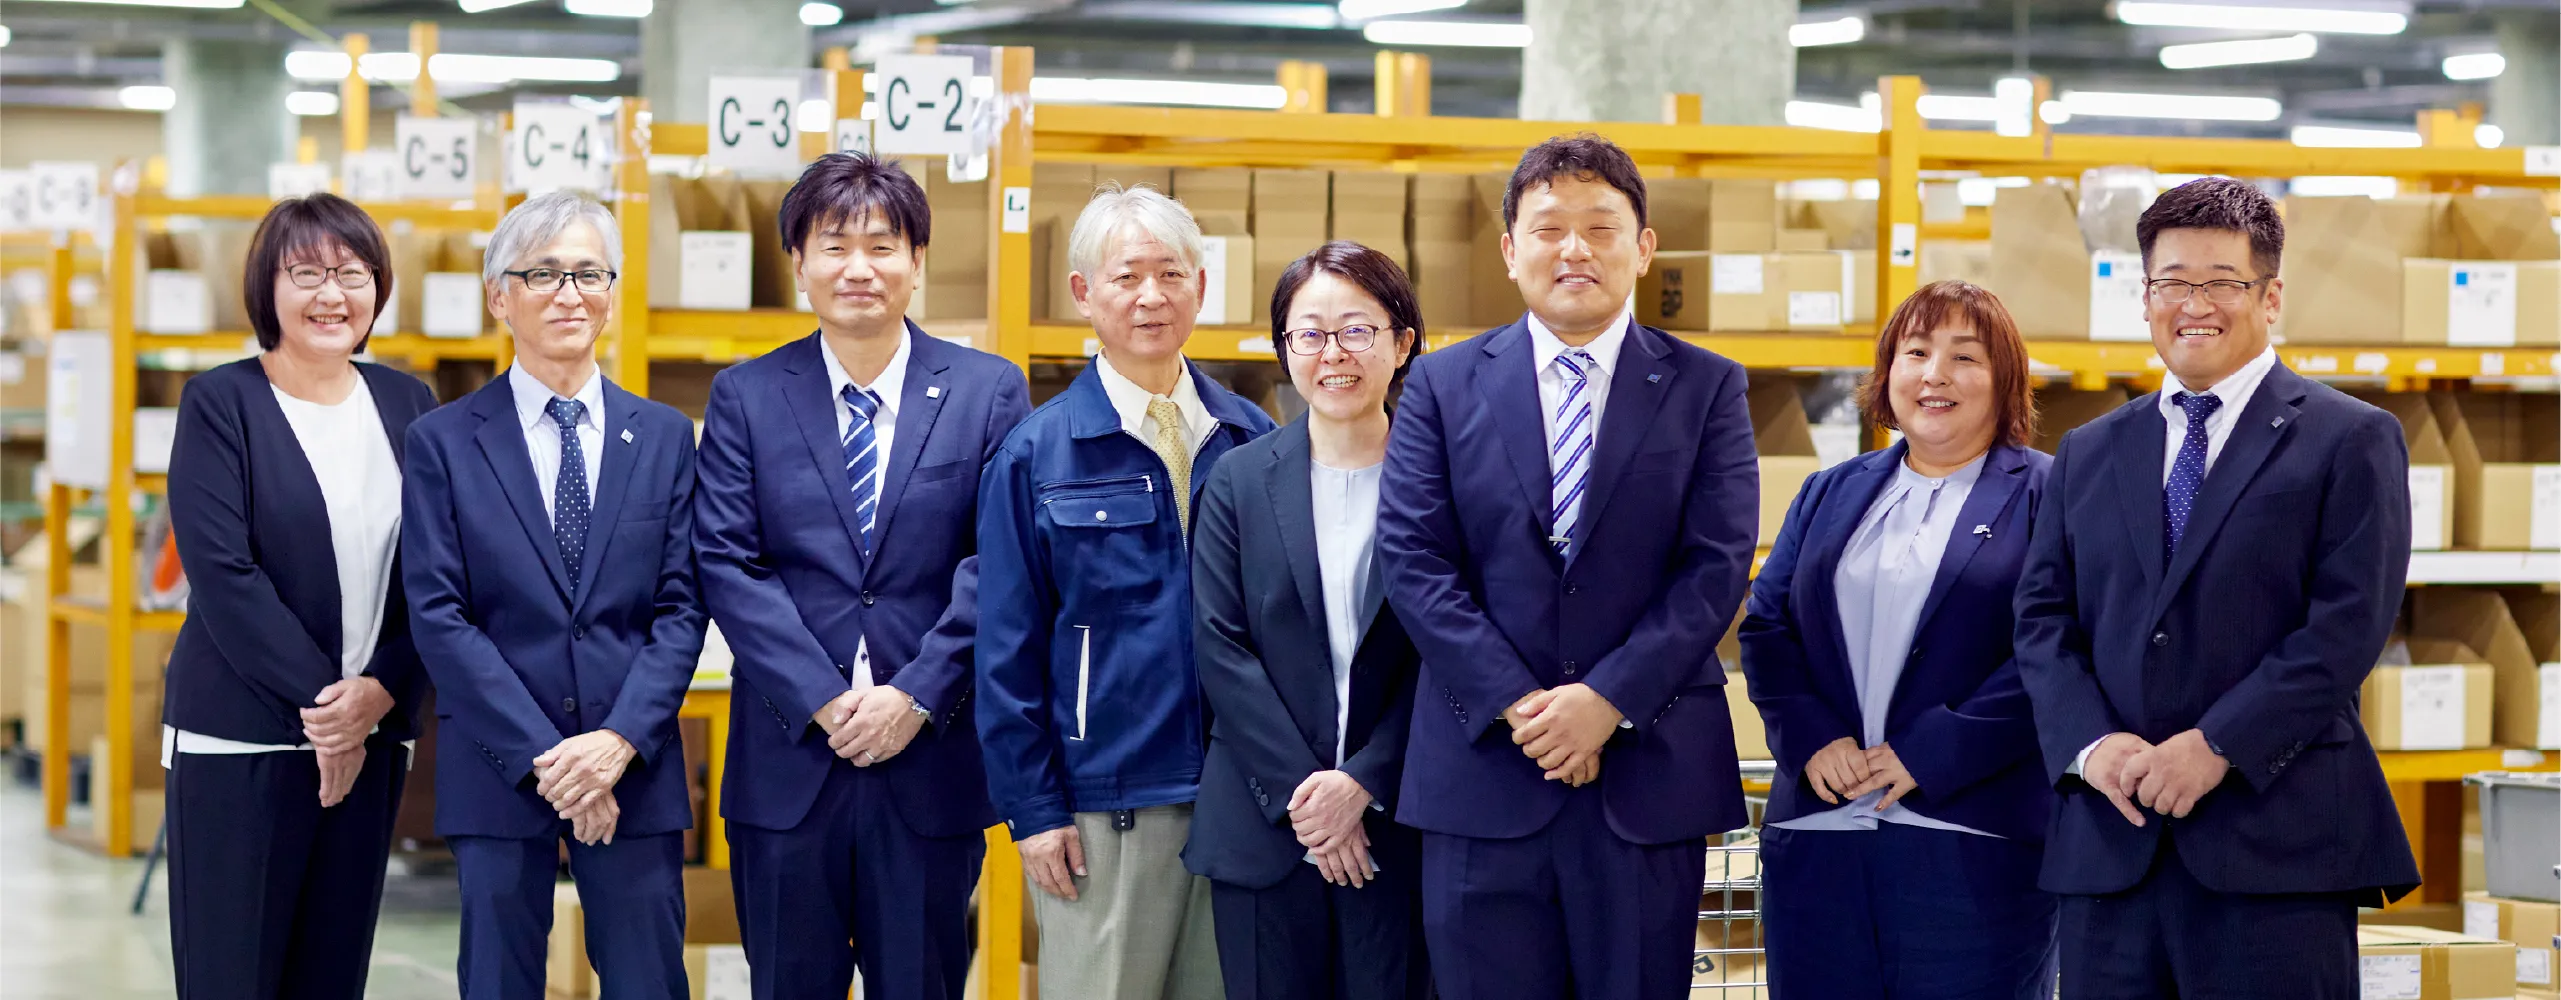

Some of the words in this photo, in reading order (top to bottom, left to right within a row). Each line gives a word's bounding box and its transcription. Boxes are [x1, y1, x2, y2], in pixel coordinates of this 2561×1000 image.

[719, 96, 790, 147] C-3
[887, 76, 964, 132] C-2
[406, 134, 468, 179] C-5
[523, 123, 589, 173] C-4
